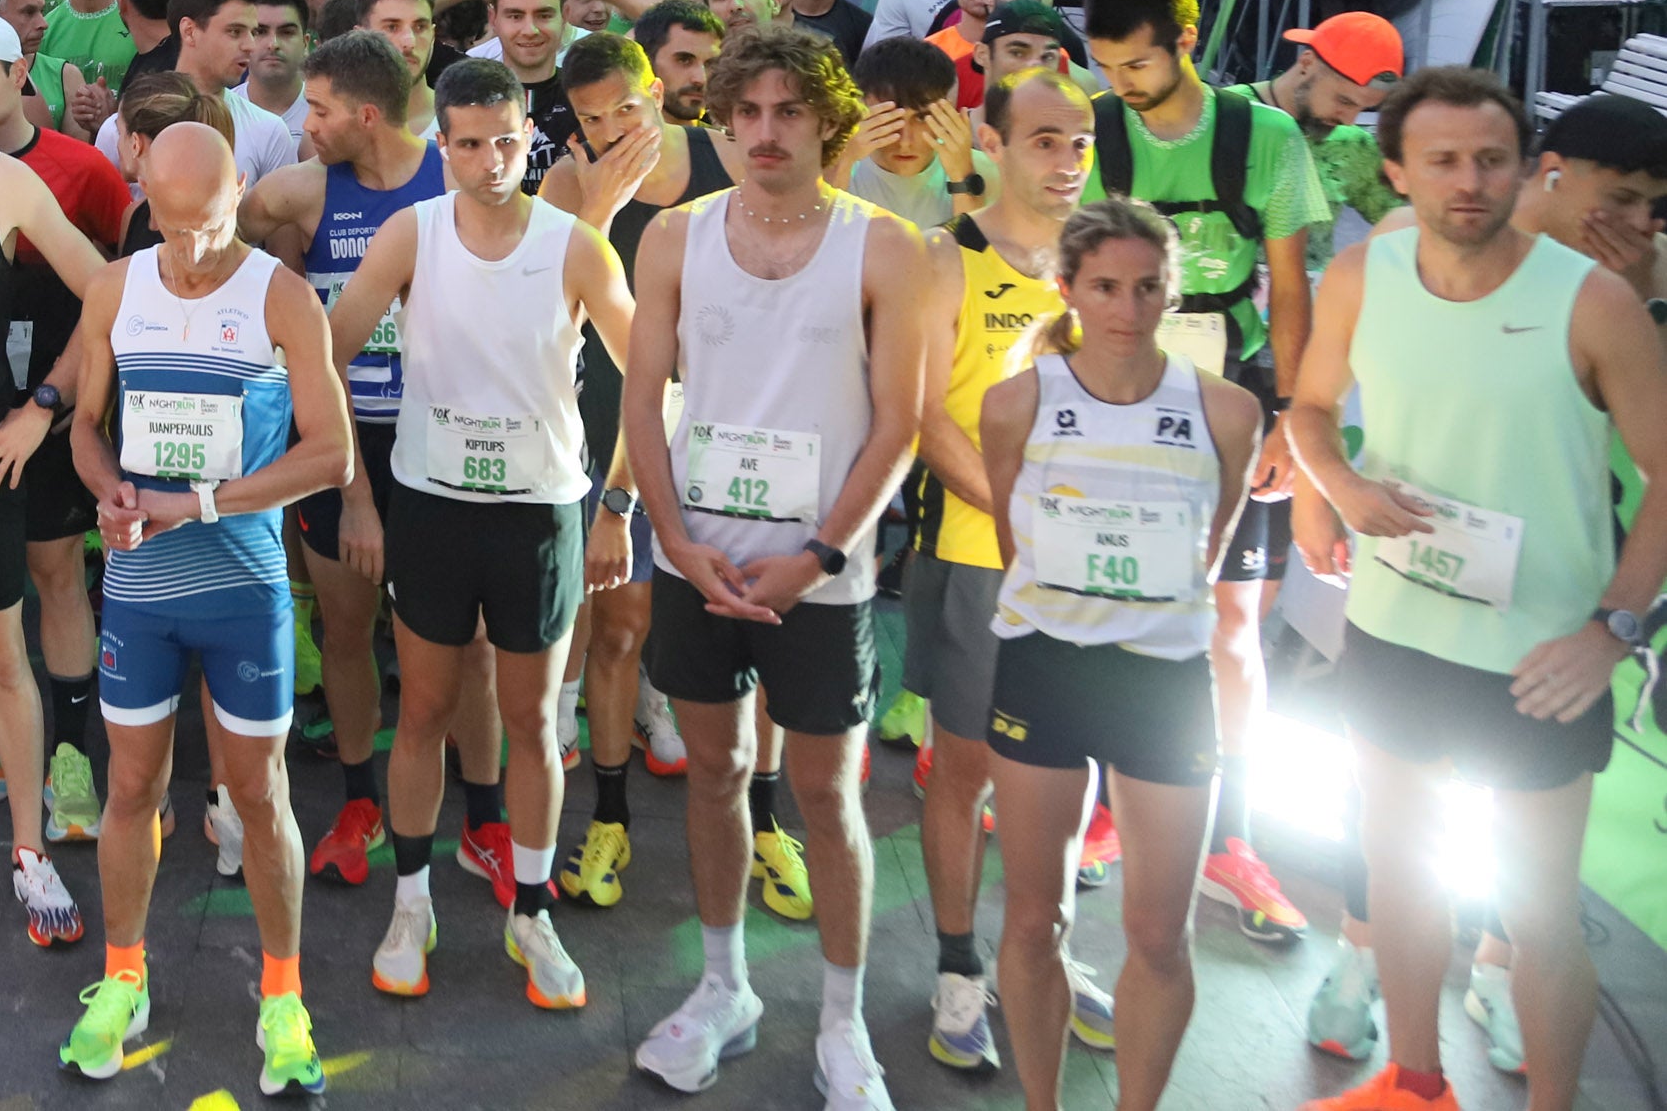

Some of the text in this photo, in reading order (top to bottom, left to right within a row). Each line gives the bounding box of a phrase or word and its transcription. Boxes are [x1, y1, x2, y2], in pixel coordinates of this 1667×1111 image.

[329, 229, 346, 237] CLUB
[130, 393, 146, 409] 10K
[433, 407, 451, 423] 10K
[149, 422, 213, 436] JUANPEPAULIS
[534, 420, 539, 432] 1
[693, 425, 715, 441] 10K
[1157, 416, 1192, 440] PA
[465, 438, 505, 452] KIPTUPS
[154, 441, 206, 470] 1295
[463, 456, 506, 482] 683
[739, 457, 759, 471] AVE
[727, 476, 770, 506] 412
[1408, 539, 1466, 582] 1457
[1086, 553, 1139, 585] F40
